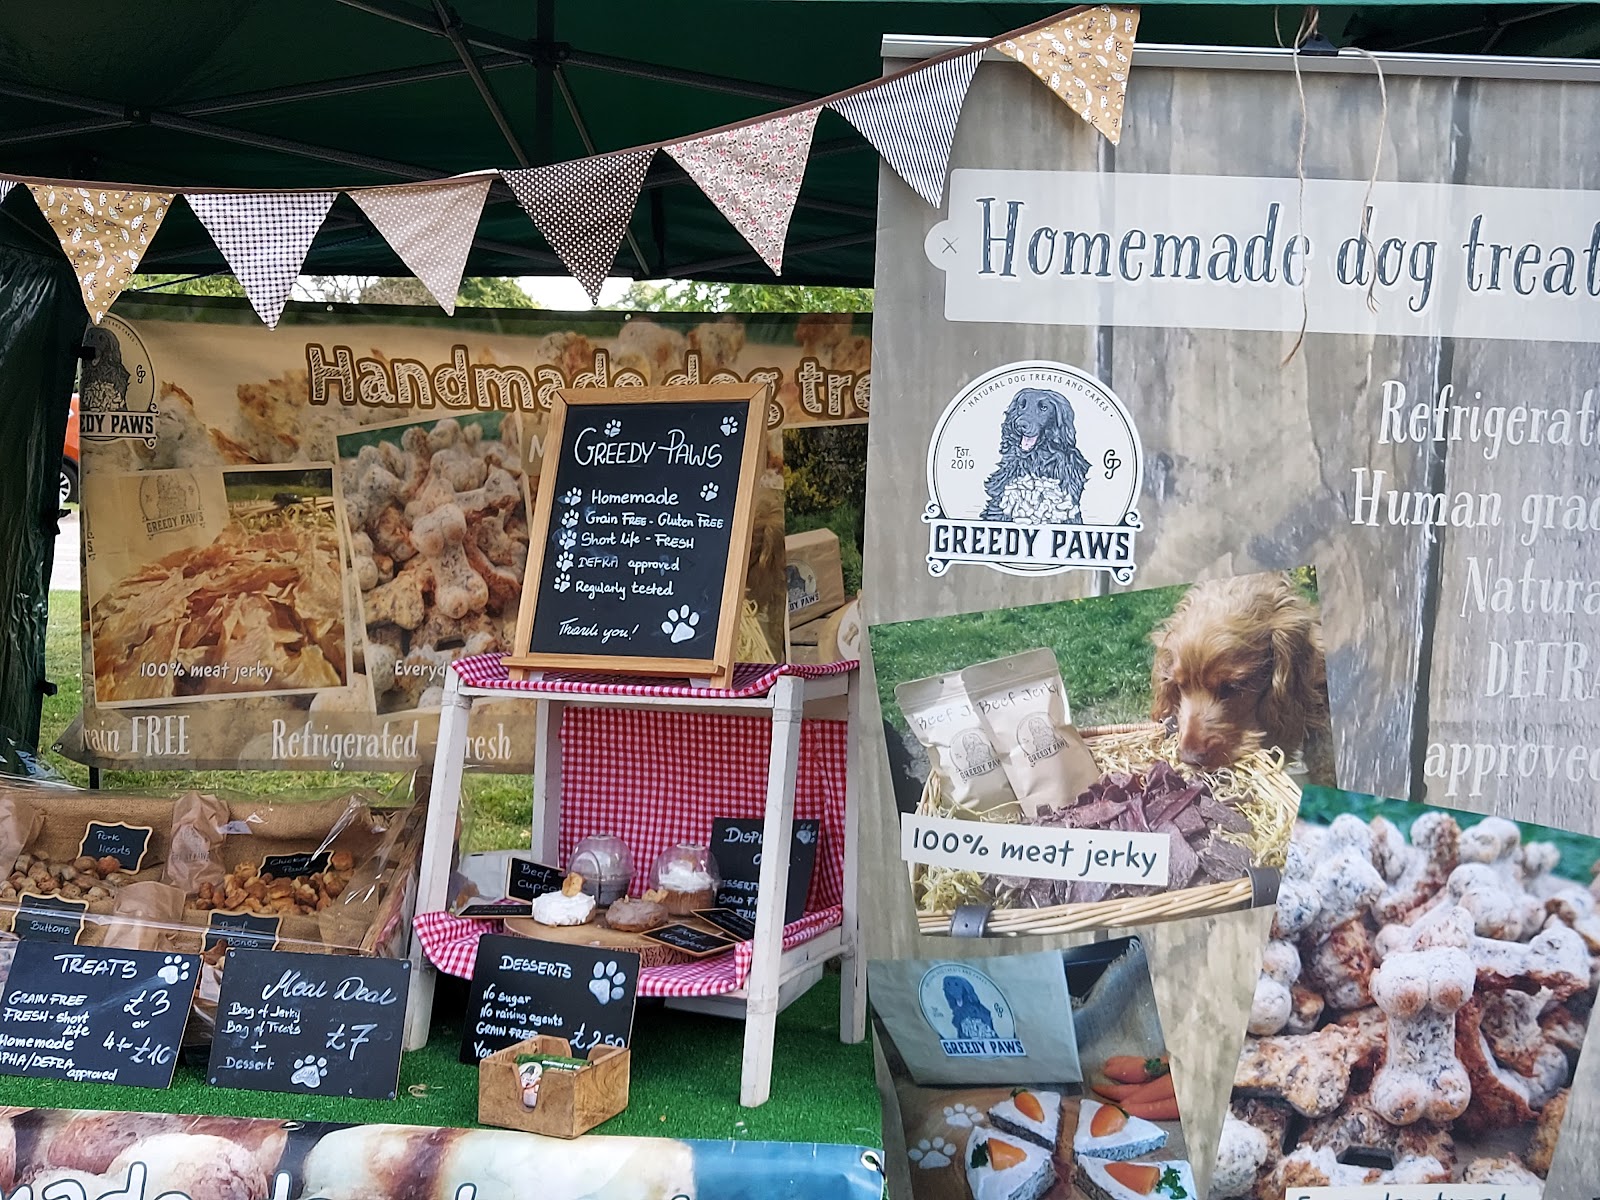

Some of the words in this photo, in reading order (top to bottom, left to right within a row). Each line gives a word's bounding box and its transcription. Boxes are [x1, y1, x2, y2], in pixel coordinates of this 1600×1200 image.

[977, 197, 1309, 287] Homemade
[1336, 205, 1438, 314] dog
[968, 380, 1006, 408] NATURAL
[1008, 374, 1026, 385] DOG
[1029, 373, 1063, 384] TREATS
[1065, 379, 1083, 392] AND
[1084, 389, 1109, 412] CAKES
[111, 415, 154, 434] PAWS
[1377, 380, 1600, 460] Refrigerat
[950, 459, 975, 470] 2019
[592, 487, 680, 506] Homemade
[1351, 467, 1501, 528] Human
[581, 532, 616, 547] Short
[655, 534, 694, 549] FRESH
[934, 524, 1042, 558] GREEDY
[1051, 530, 1130, 561] PAWS
[577, 556, 619, 569] DEFRA
[628, 558, 680, 578] approved
[575, 581, 626, 601] Regularly
[631, 581, 674, 597] tested
[140, 662, 186, 678] 100%
[190, 661, 230, 680] meat
[231, 660, 274, 685] jerky
[977, 691, 1015, 716] Beef
[130, 715, 191, 757] FREE
[271, 719, 418, 763] Refrigerated
[464, 722, 512, 761] resh
[913, 827, 989, 857] 100%
[1000, 839, 1075, 868] meat
[1078, 840, 1158, 878] jerky
[719, 894, 744, 905] SOLD
[30, 921, 70, 935] Buttons
[54, 954, 138, 979] TREATS
[499, 955, 573, 979] DESSERTS
[262, 969, 328, 1001] Meal
[333, 976, 397, 1006] Deal
[483, 983, 496, 1001] No
[497, 991, 532, 1008] sugar
[3, 1007, 49, 1022] FRESH
[8, 990, 49, 1005] GRAIN
[50, 993, 88, 1006] FREE
[123, 989, 171, 1017] £3
[228, 1002, 254, 1020] Bag
[270, 1005, 301, 1023] Jerky
[480, 1002, 493, 1019] No
[495, 1008, 527, 1025] raising
[528, 1014, 564, 1028] agents
[103, 1031, 115, 1050] 4
[221, 1020, 250, 1039] Bag
[476, 1021, 507, 1037] GRAIN
[325, 1023, 378, 1061] £7
[943, 1041, 988, 1055] GREEDY
[989, 1041, 1024, 1054] PAWS
[67, 1068, 119, 1082] approved
[218, 1056, 275, 1071] Dessert
